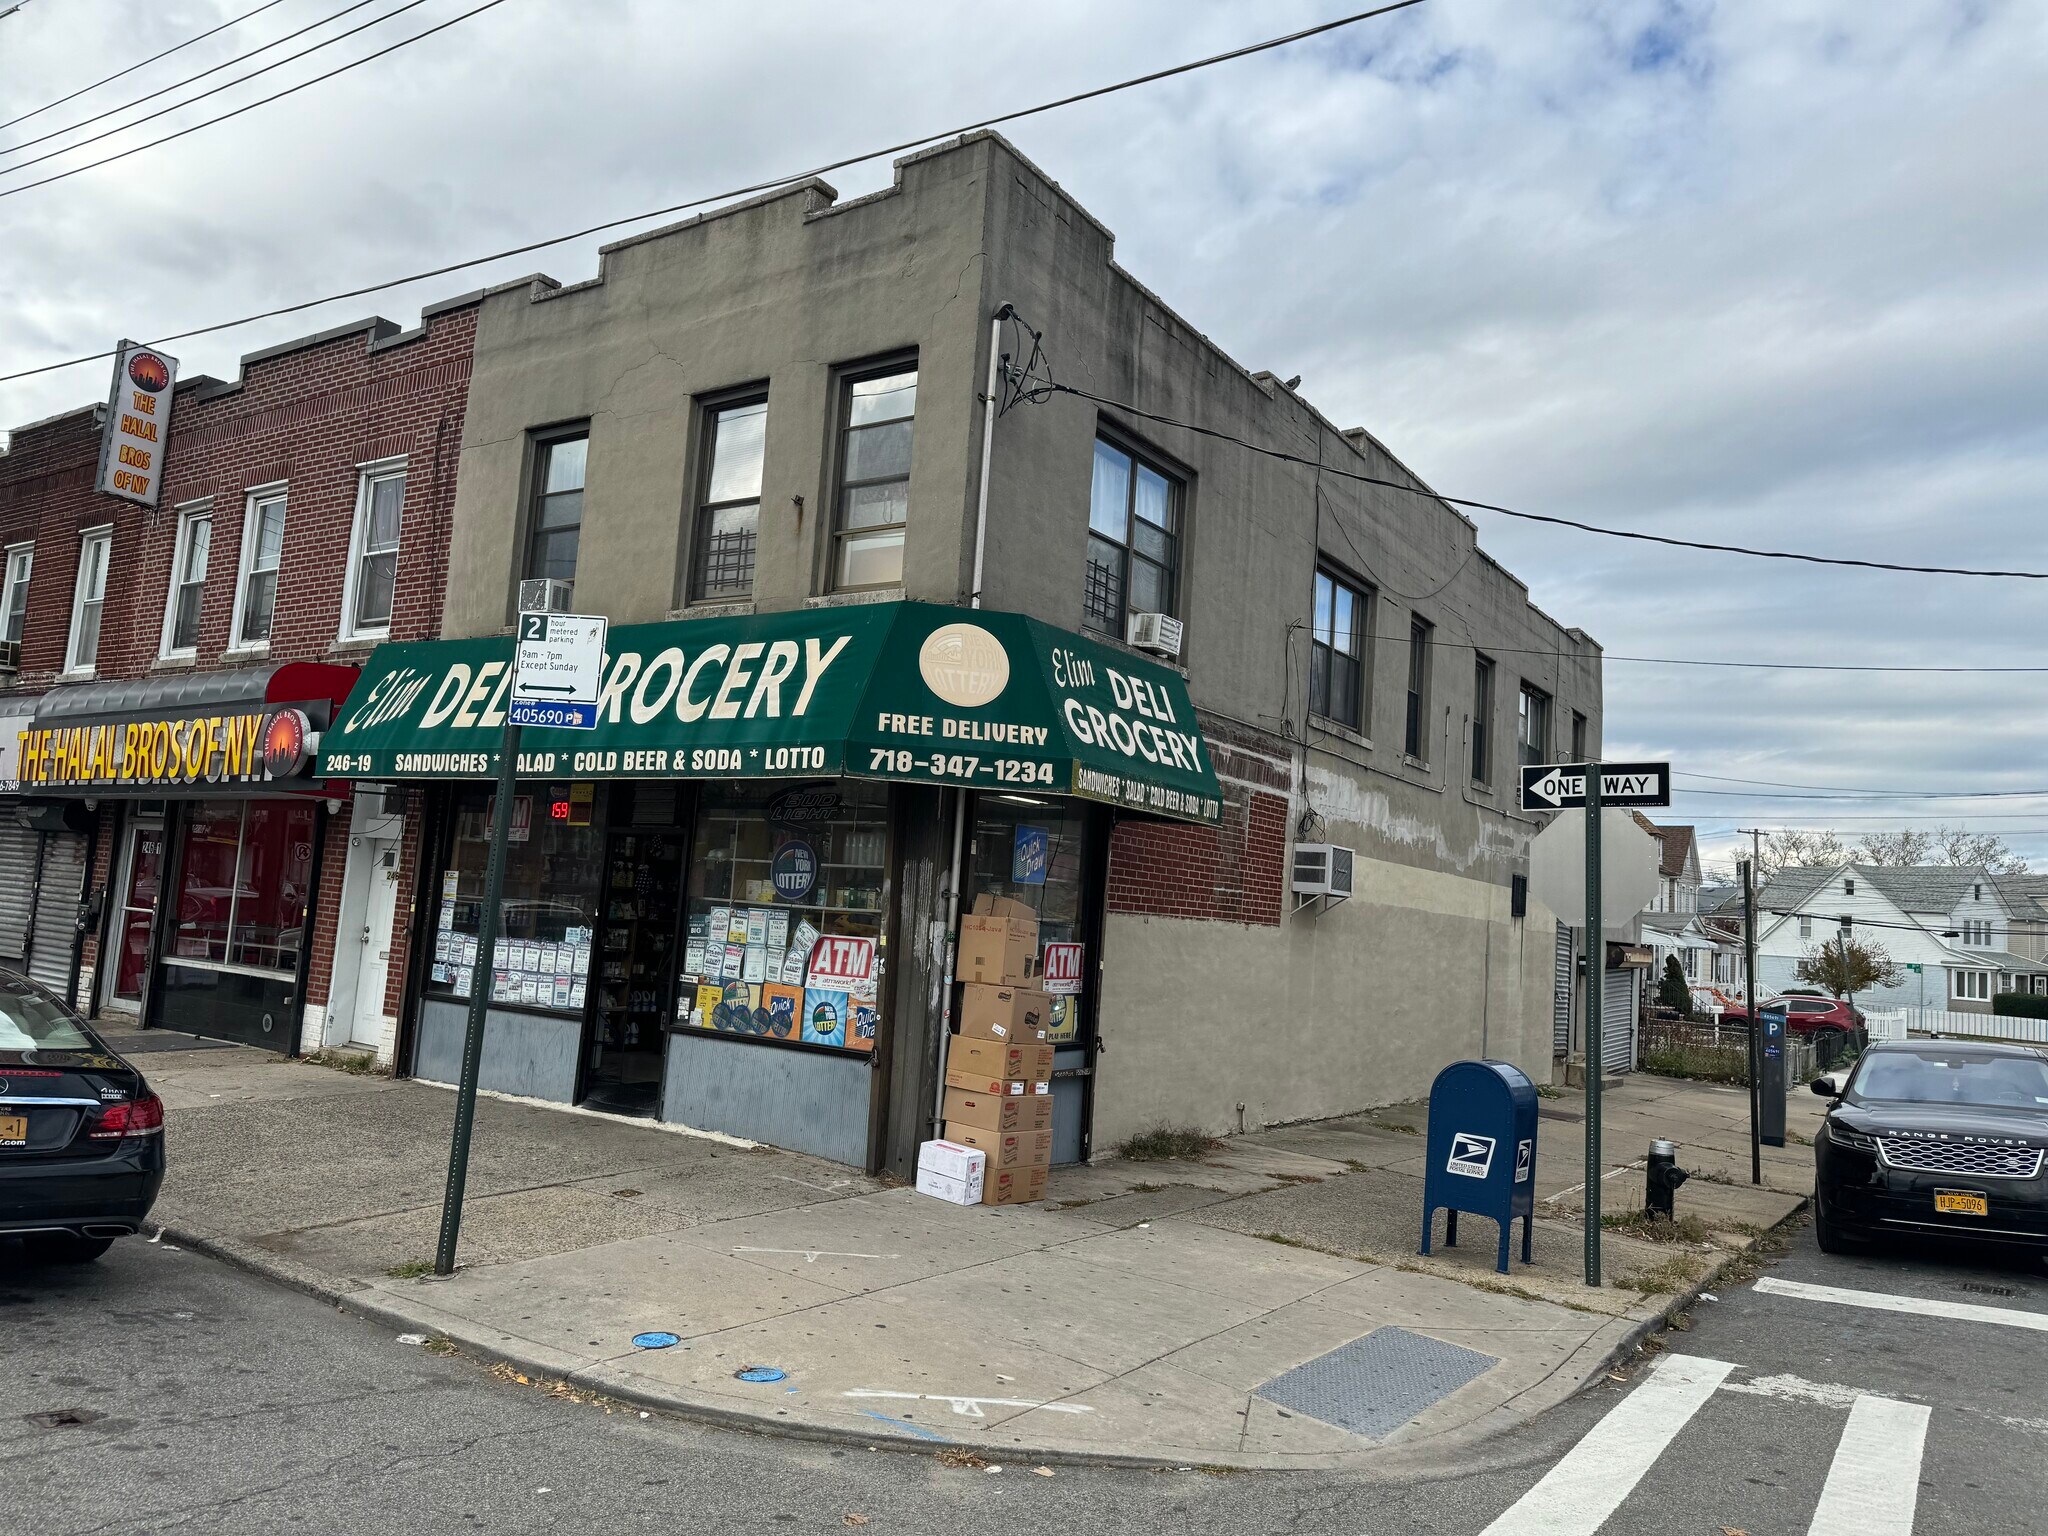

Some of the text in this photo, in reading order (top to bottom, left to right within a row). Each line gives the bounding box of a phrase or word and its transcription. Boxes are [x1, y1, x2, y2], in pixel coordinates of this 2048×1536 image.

[133, 391, 156, 415] THE
[121, 414, 158, 442] HALAL
[118, 444, 152, 470] BROS
[114, 470, 150, 495] OF NY
[527, 617, 541, 639] 2
[549, 628, 578, 636] metered
[549, 635, 574, 645] parking
[521, 650, 538, 659] 9am
[547, 651, 563, 661] 7pm
[521, 660, 578, 673] Except Sunday
[344, 635, 853, 734] Elim DEL ROCERY
[1052, 647, 1176, 724] Elim DELI
[267, 712, 282, 734] HALAL
[284, 711, 297, 725] BROS
[512, 707, 563, 725] 405690
[877, 712, 1048, 746] FREE DELIVERY
[1064, 698, 1203, 773] GROCERY
[16, 713, 264, 781] THE HALAL BROS OF NY
[326, 754, 372, 772] 246-19
[395, 746, 825, 773] SANDWICHES ALAD COLD BEER & SODA LOTTO
[869, 748, 1054, 784] 718-347-1234
[1078, 768, 1121, 797] SANDWICHES
[1125, 779, 1145, 803] SALAD
[1150, 786, 1165, 806] COLD
[1165, 789, 1180, 811] BEER
[1185, 794, 1199, 815] SODA
[1203, 798, 1219, 819] LOTTO
[1544, 776, 1649, 796] ONE WAY
[551, 802, 568, 818] 159
[785, 793, 838, 808] BUD
[771, 807, 838, 821] LIGHT
[794, 848, 809, 860] NEW
[1021, 836, 1041, 862] Quick
[795, 859, 812, 871] YORK
[1026, 853, 1044, 877] Draw
[776, 872, 812, 890] LOTTERY
[813, 939, 870, 976] ATM
[1046, 946, 1081, 978] ATM
[770, 997, 791, 1015] Quick
[815, 1020, 837, 1032] LOTTERY
[857, 1009, 876, 1027] Quic
[861, 1025, 875, 1038] Dra
[1769, 1022, 1778, 1035] P
[1888, 1130, 2027, 1145] RANGE ROVER
[1450, 1161, 1467, 1169] UNITED
